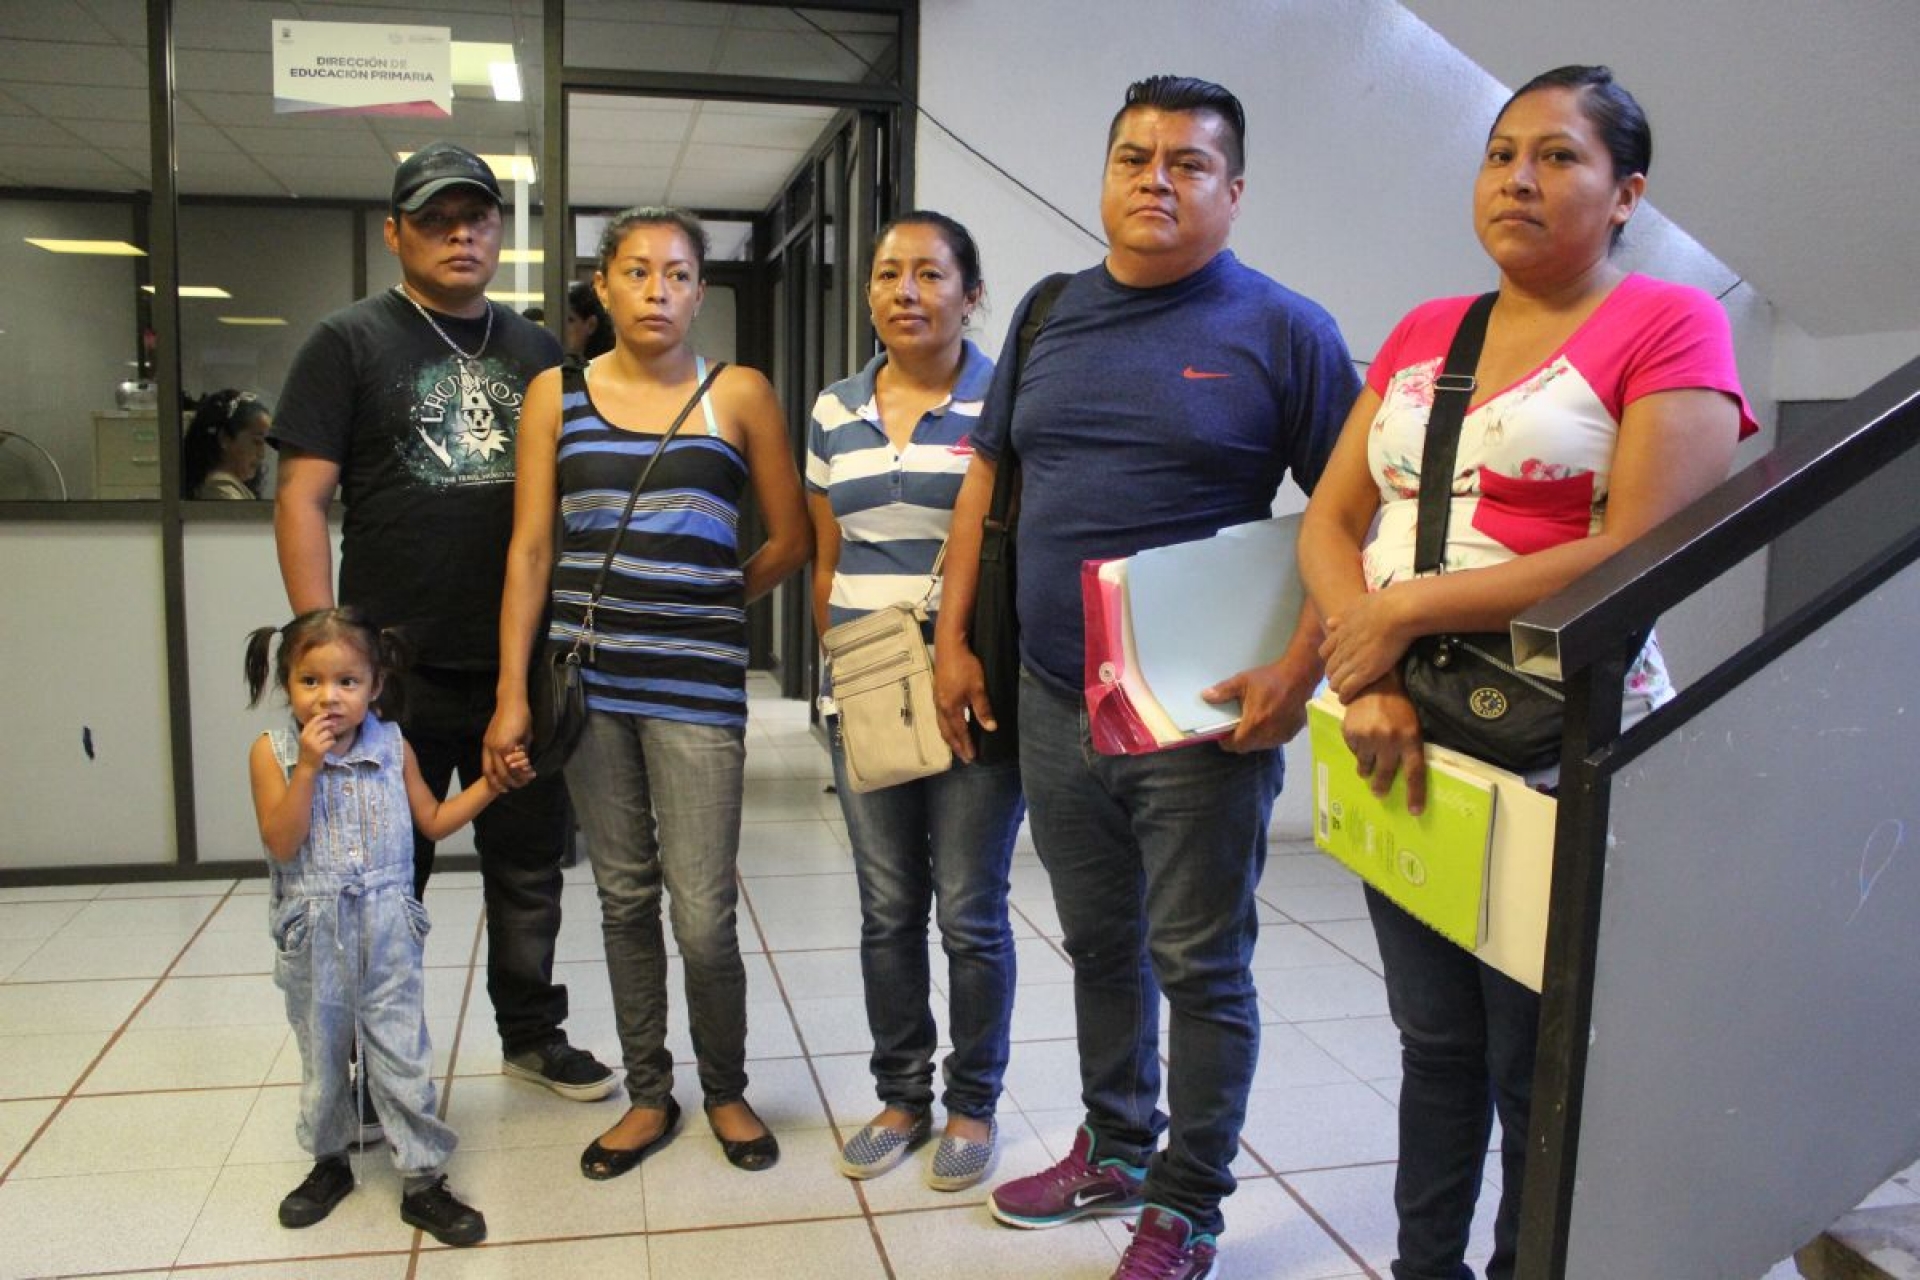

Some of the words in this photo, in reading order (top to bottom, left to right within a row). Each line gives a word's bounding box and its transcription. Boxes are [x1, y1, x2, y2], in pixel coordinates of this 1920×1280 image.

[316, 56, 388, 68] DIRECCIÓN
[390, 59, 407, 69] DE
[370, 70, 434, 82] PRIMARIA
